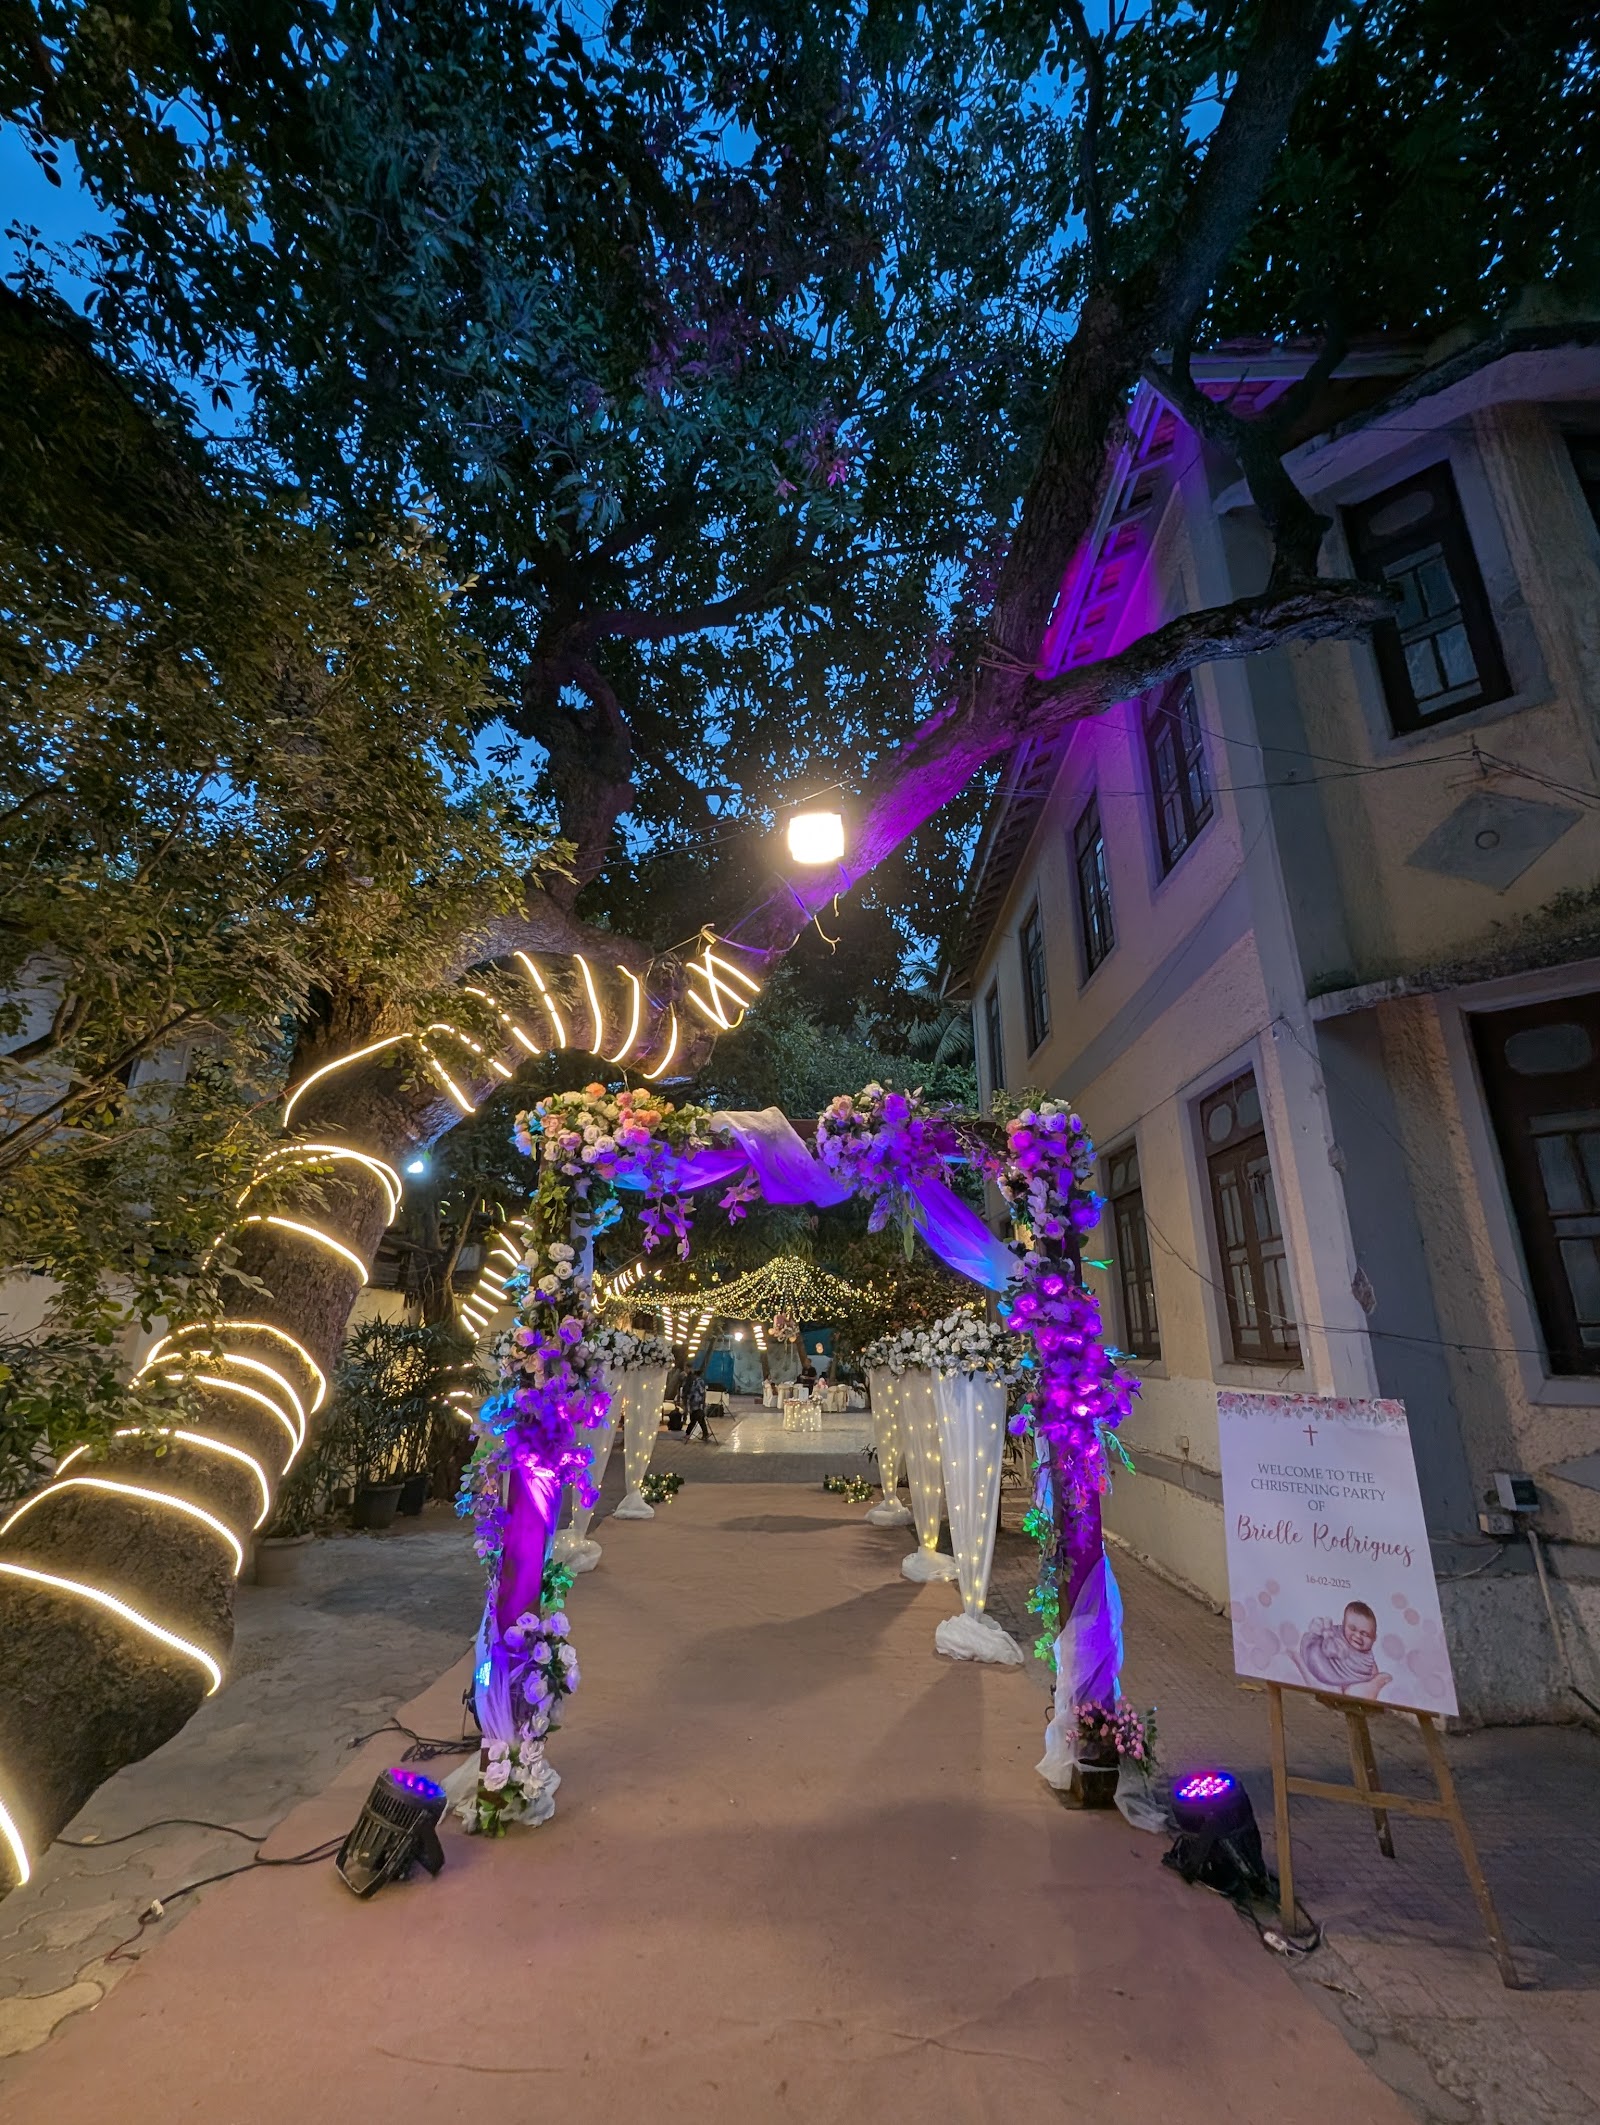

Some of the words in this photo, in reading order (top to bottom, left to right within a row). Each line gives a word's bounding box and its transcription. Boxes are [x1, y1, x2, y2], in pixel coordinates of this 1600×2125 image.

[1257, 1463, 1323, 1479] WELCOME
[1325, 1469, 1345, 1481] TO
[1347, 1470, 1375, 1484] THE
[1250, 1478, 1340, 1497] CHRISTENING
[1343, 1486, 1386, 1501] PARTY
[1307, 1499, 1325, 1512] OF
[1237, 1514, 1303, 1545] Brielle
[1313, 1522, 1415, 1567] Rodrigues
[1305, 1574, 1352, 1589] 16-02-2025
